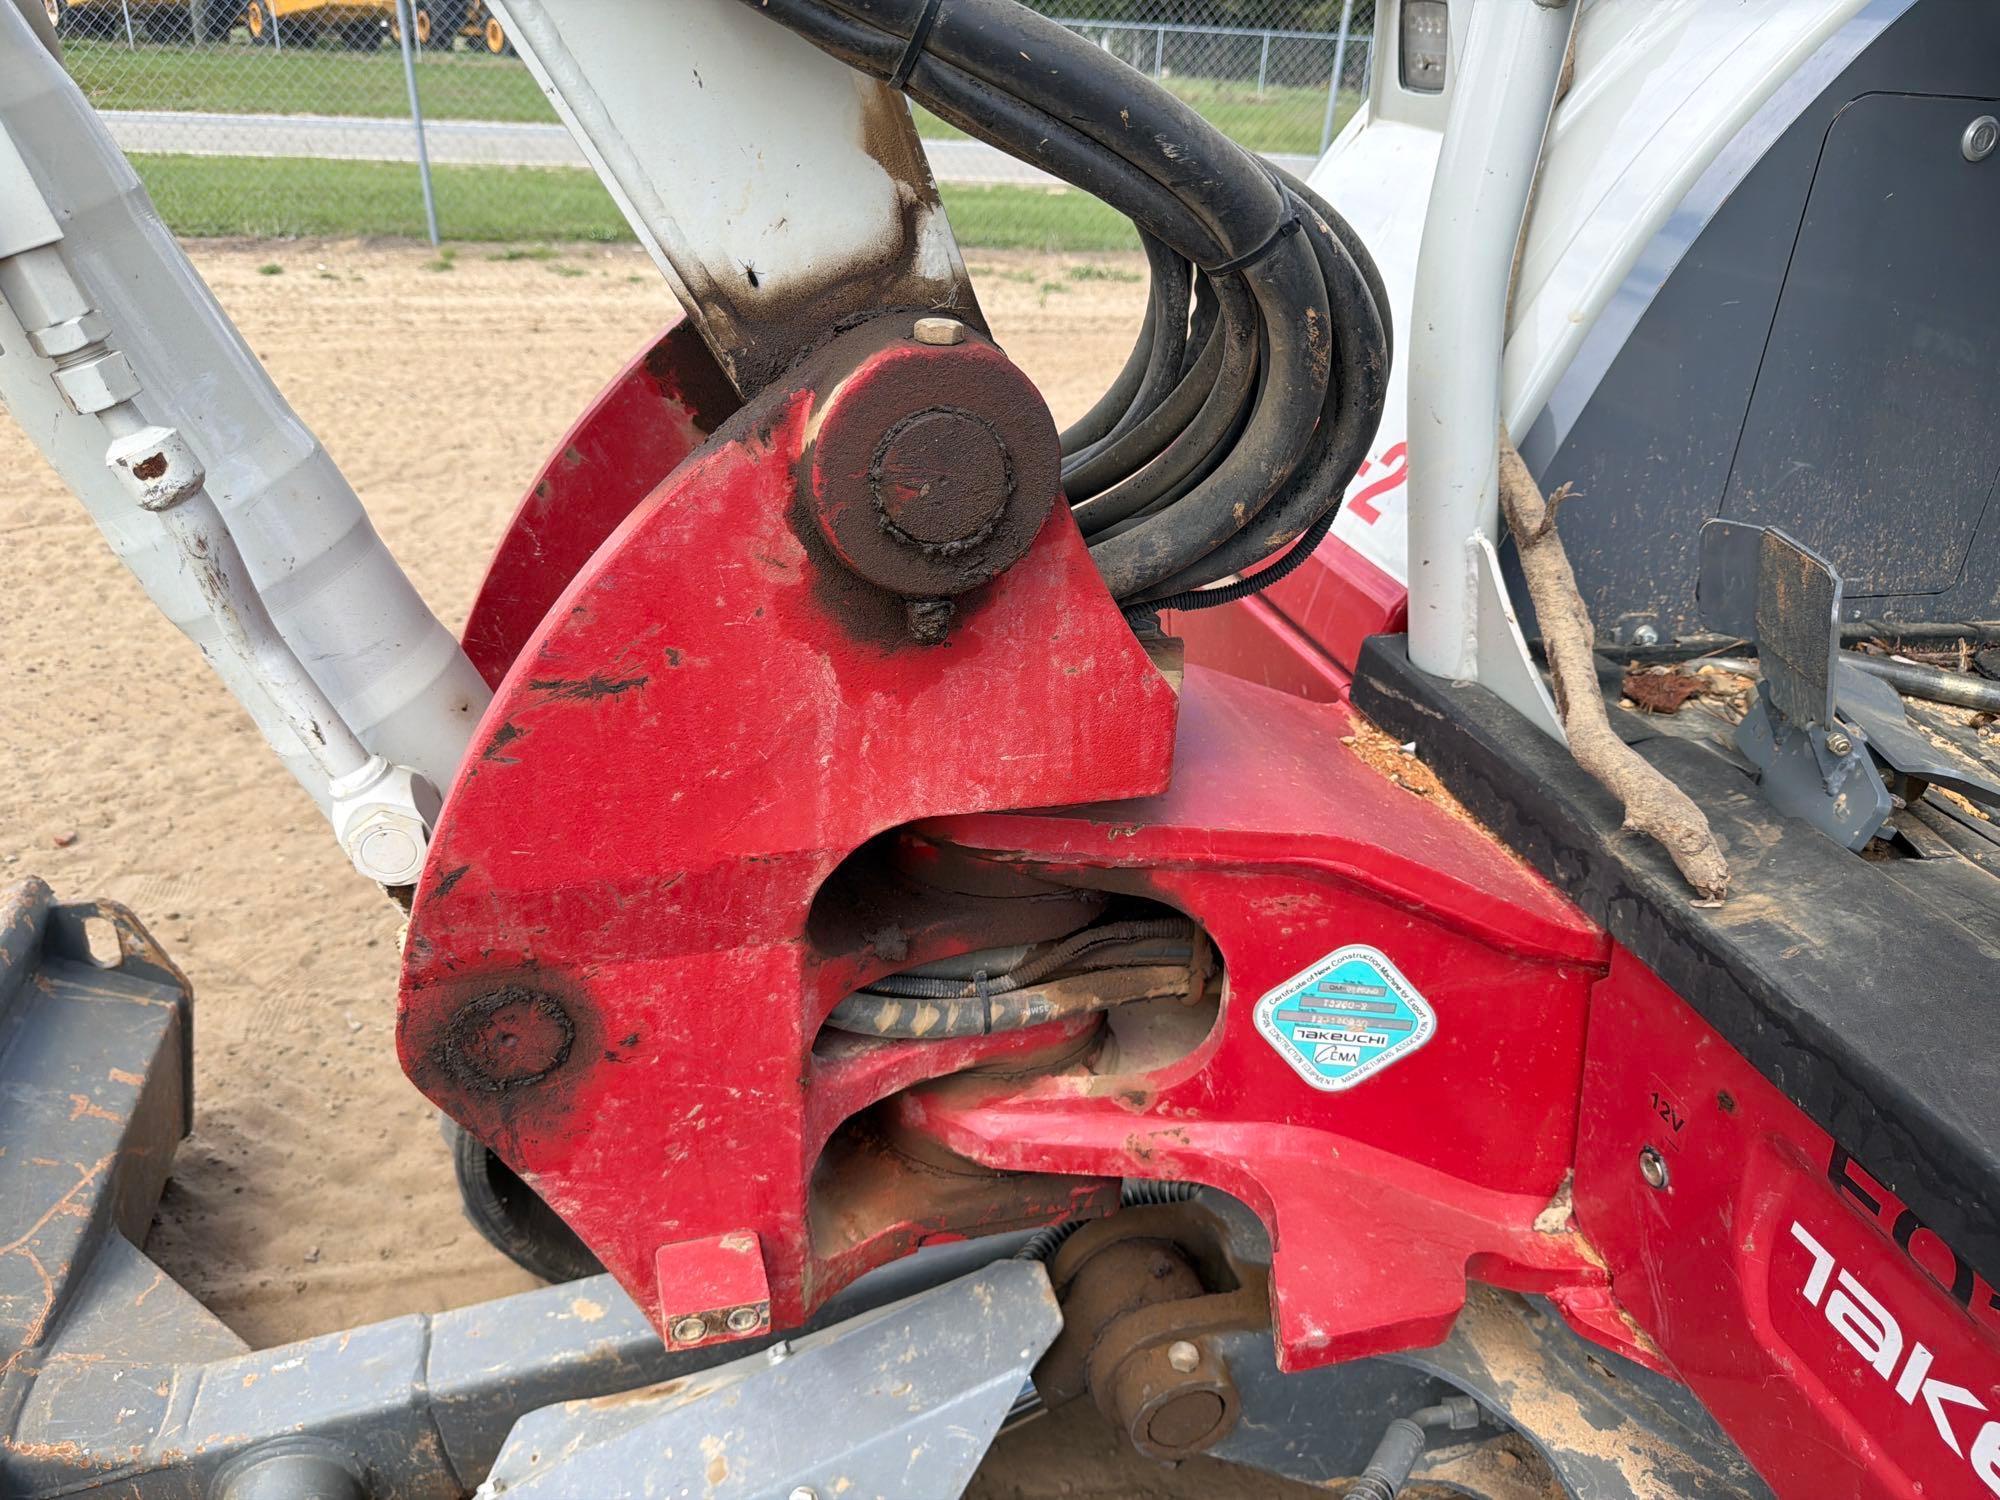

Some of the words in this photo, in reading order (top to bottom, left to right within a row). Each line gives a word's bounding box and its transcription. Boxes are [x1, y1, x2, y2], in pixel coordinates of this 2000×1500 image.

[1269, 980, 1307, 1005] Certificate
[1314, 966, 1331, 978] New
[1331, 952, 1382, 969] Construction
[1379, 966, 1402, 991] Machine
[1400, 989, 1410, 999] for
[1407, 998, 1427, 1018] Export
[1269, 1028, 1305, 1064] CONSTRUCTION
[1301, 1063, 1335, 1086] EQUIPMENT
[1340, 1051, 1395, 1083] MANUFACTURERS
[1394, 1021, 1429, 1054] ASSOCIATION
[1651, 1092, 1685, 1132] 12V
